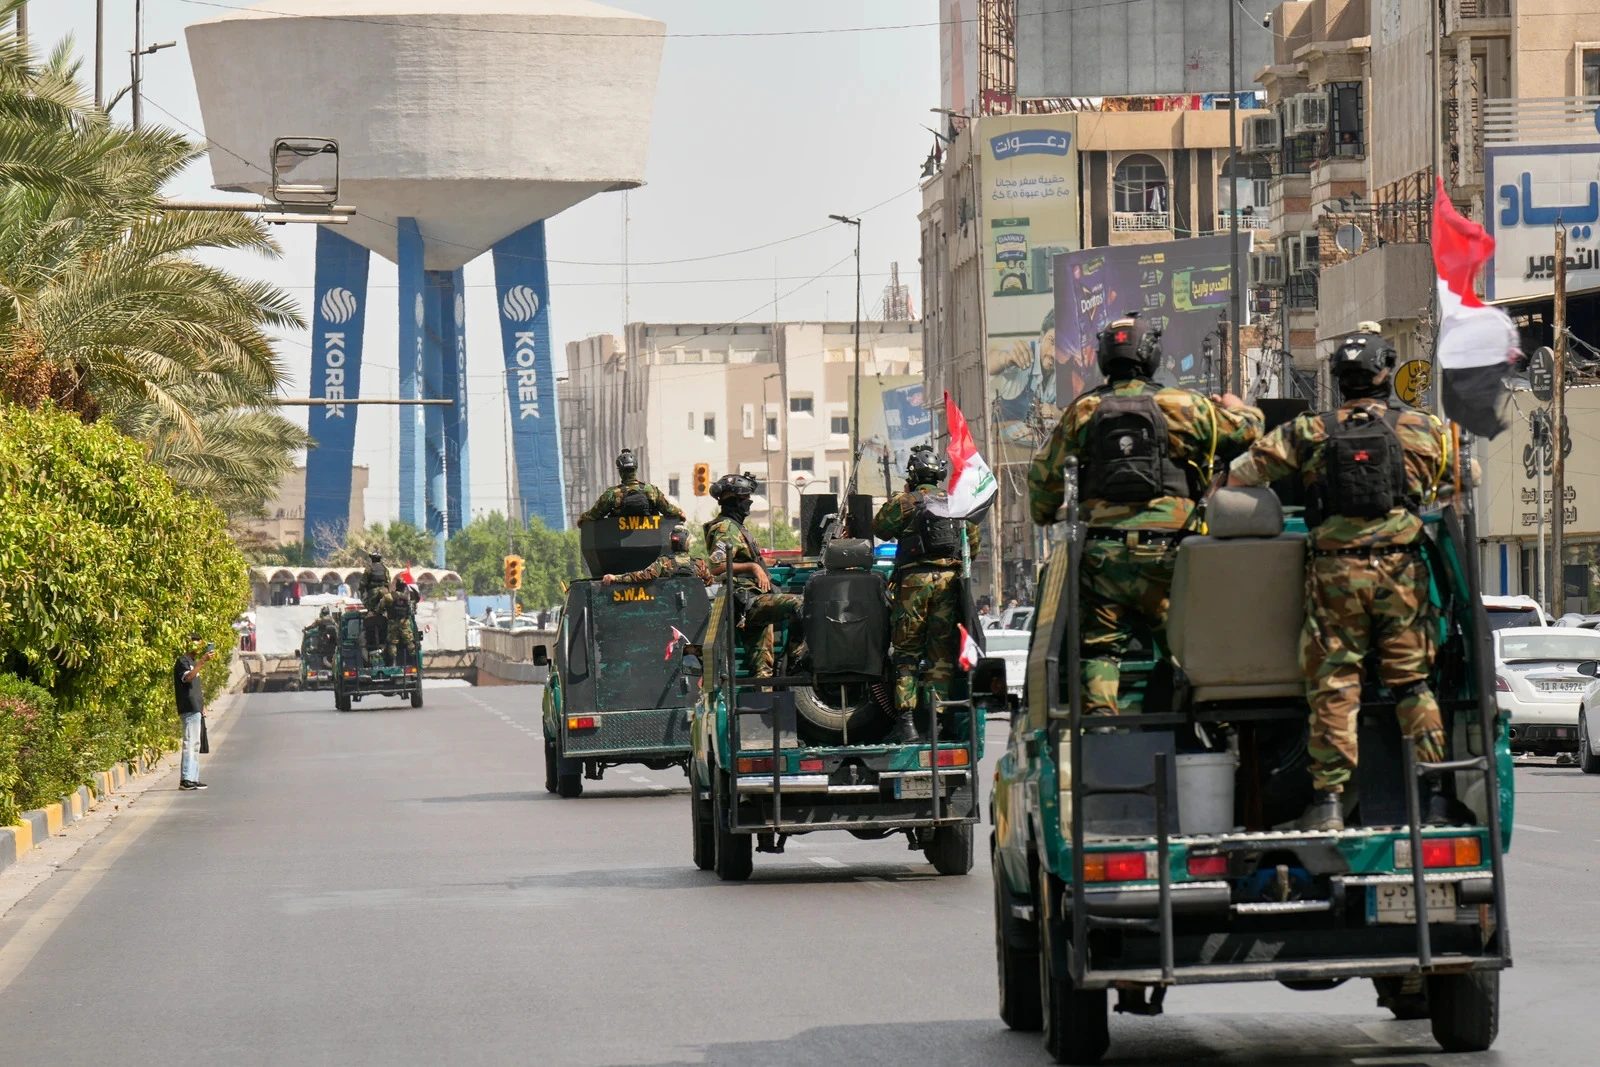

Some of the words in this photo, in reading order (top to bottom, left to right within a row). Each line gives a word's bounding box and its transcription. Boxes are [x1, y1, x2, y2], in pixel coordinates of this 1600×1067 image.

[995, 135, 1066, 153] دعوات
[1019, 176, 1037, 187] سفر
[1038, 175, 1065, 185] حقيبة
[1020, 189, 1040, 199] عبوة
[1041, 188, 1055, 198] كل
[324, 332, 345, 420] KOREK
[514, 331, 540, 420] KOREK
[618, 515, 661, 530] S.W.A.T
